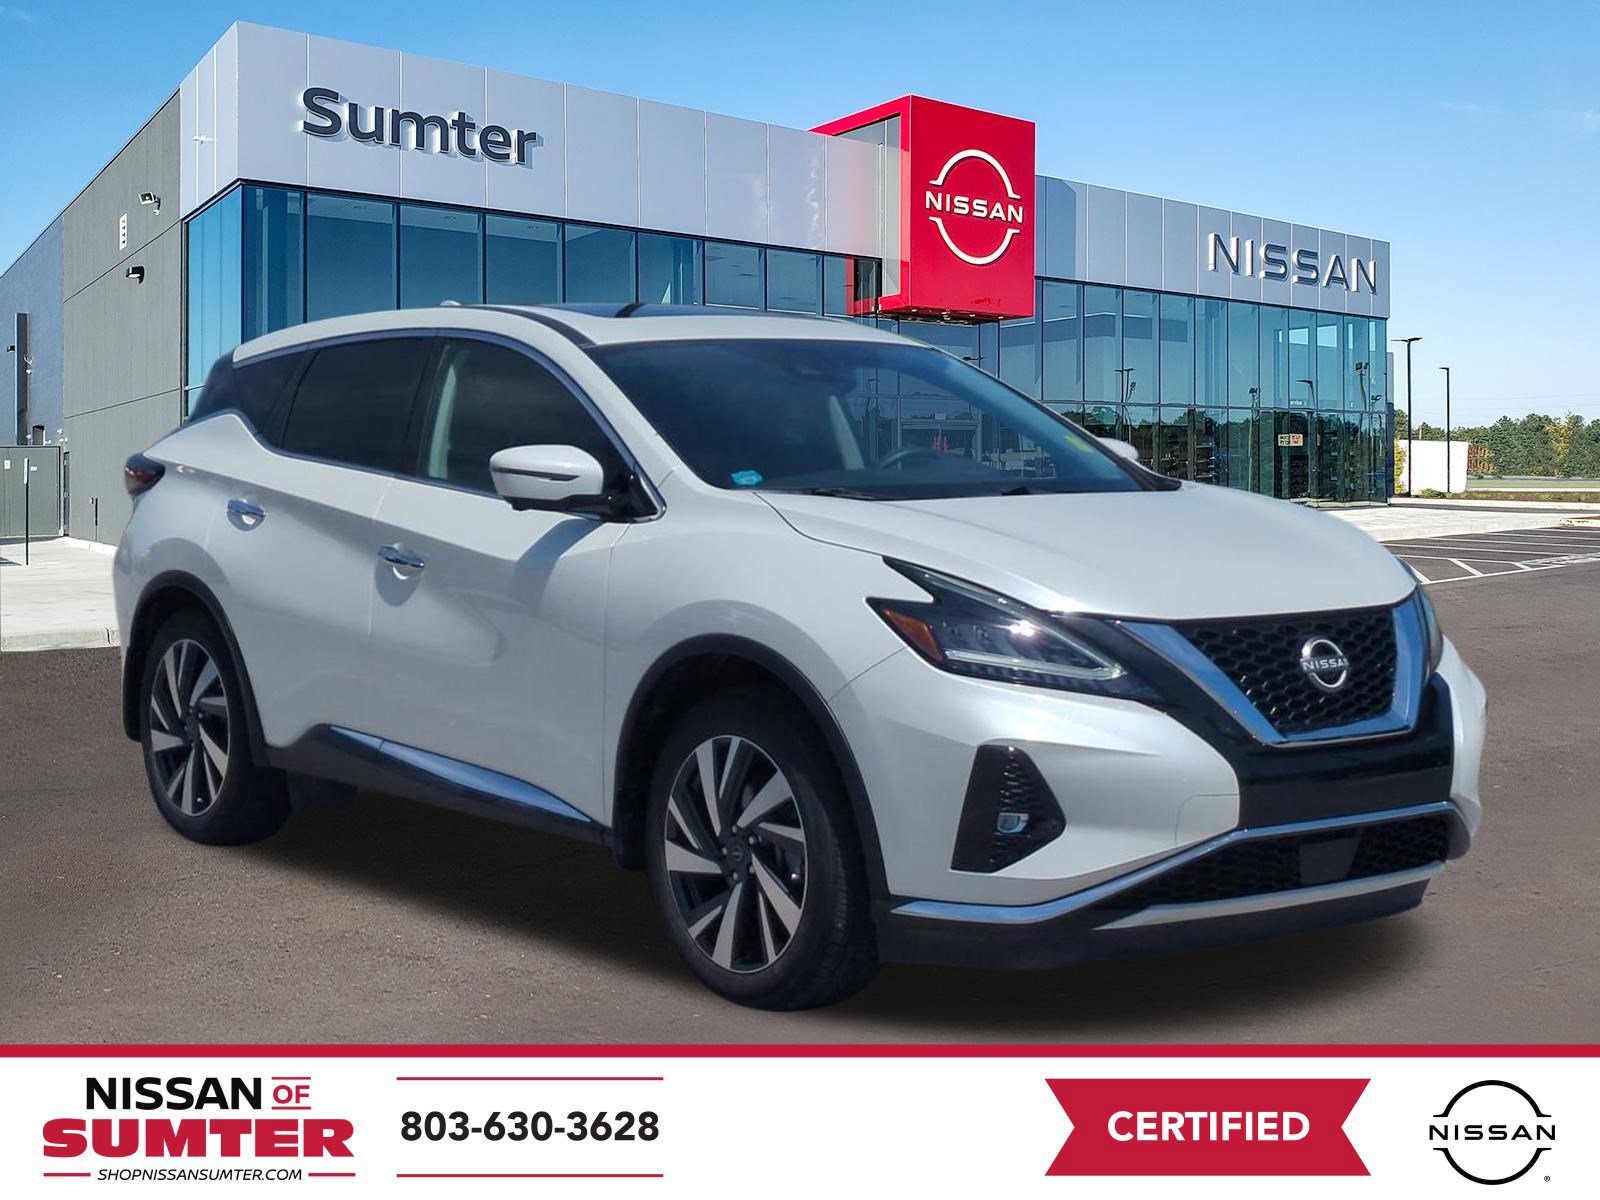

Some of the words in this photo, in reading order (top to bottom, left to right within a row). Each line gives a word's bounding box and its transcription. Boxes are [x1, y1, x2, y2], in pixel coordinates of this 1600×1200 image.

[302, 86, 537, 165] Sumter
[925, 190, 1023, 224] NISSAN
[1208, 232, 1377, 295] NISSAN
